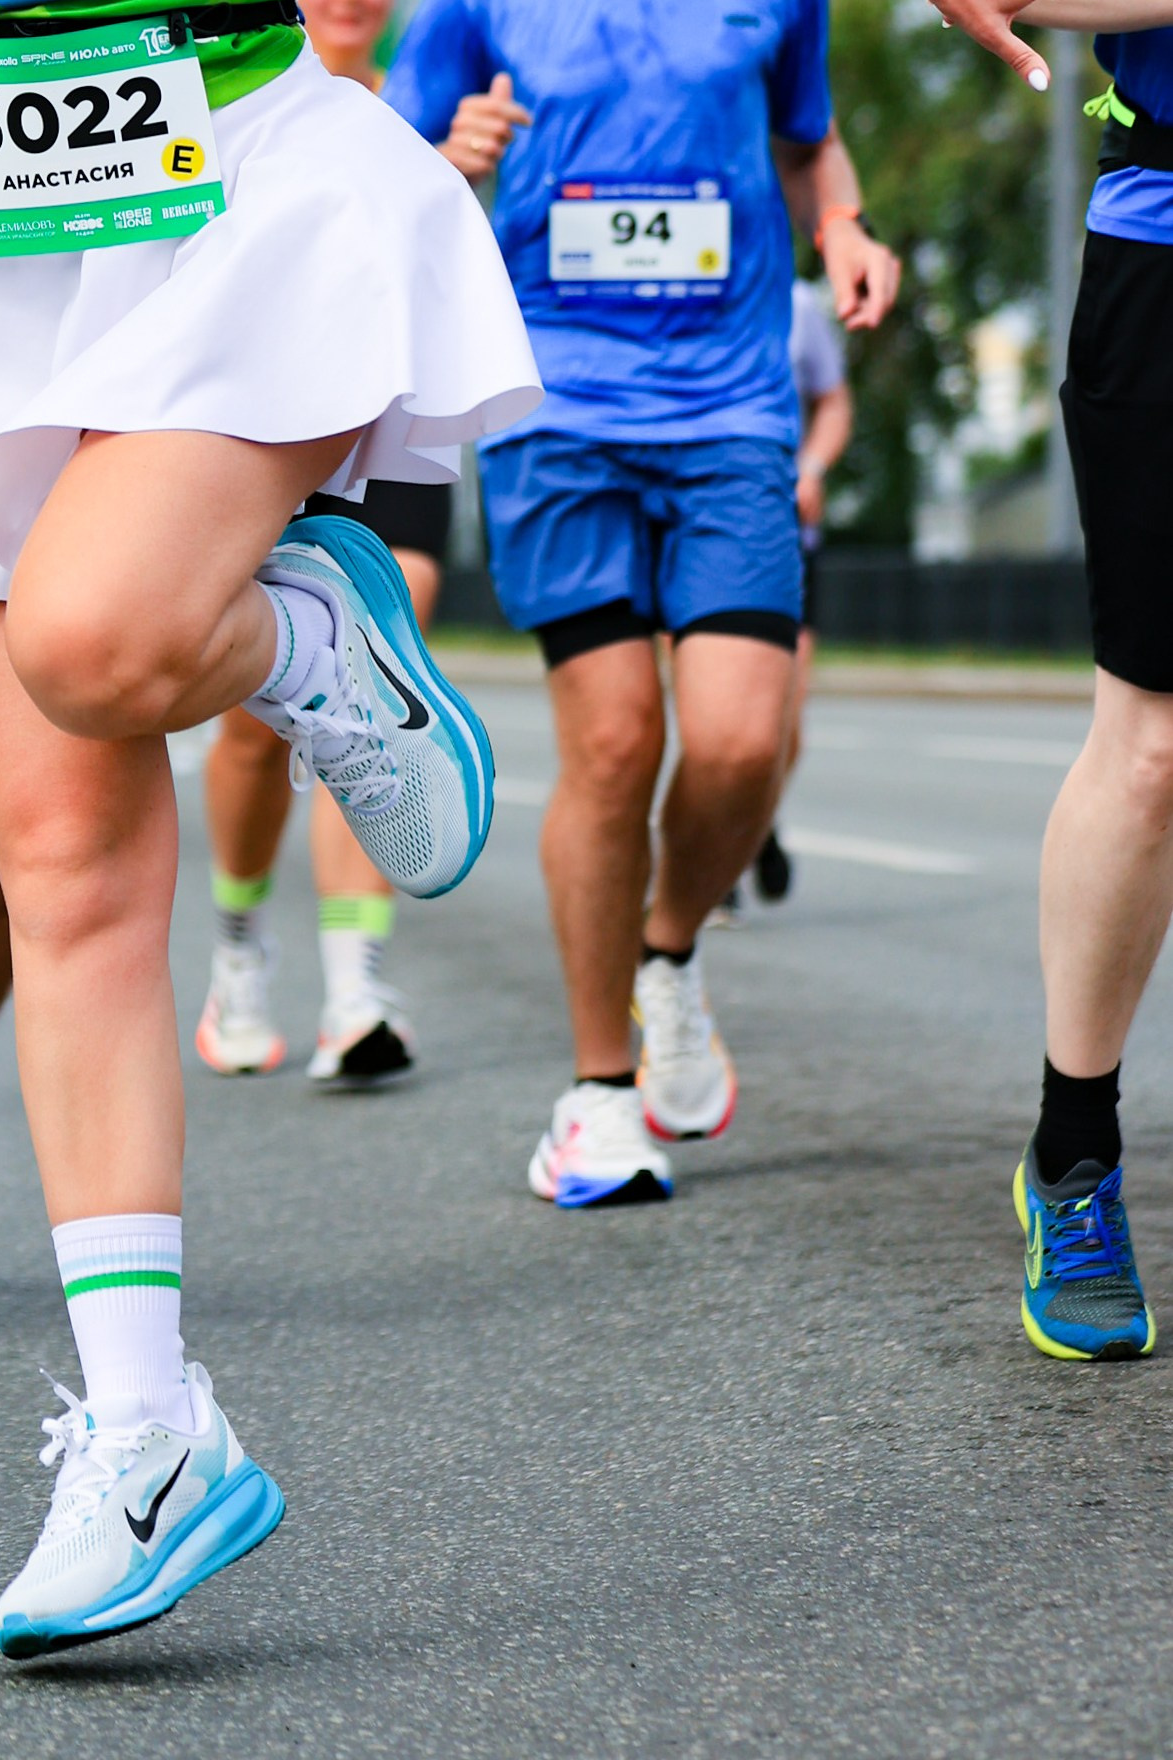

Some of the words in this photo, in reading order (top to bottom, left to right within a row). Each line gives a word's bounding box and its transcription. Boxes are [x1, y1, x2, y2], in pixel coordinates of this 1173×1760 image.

[20, 51, 66, 63] SPINE
[70, 46, 110, 62] ИЮЛЬ
[111, 43, 136, 55] авто
[3, 162, 135, 190] АНАСТАСИЯ
[162, 200, 215, 220] BERGAUER
[612, 210, 671, 244] 94
